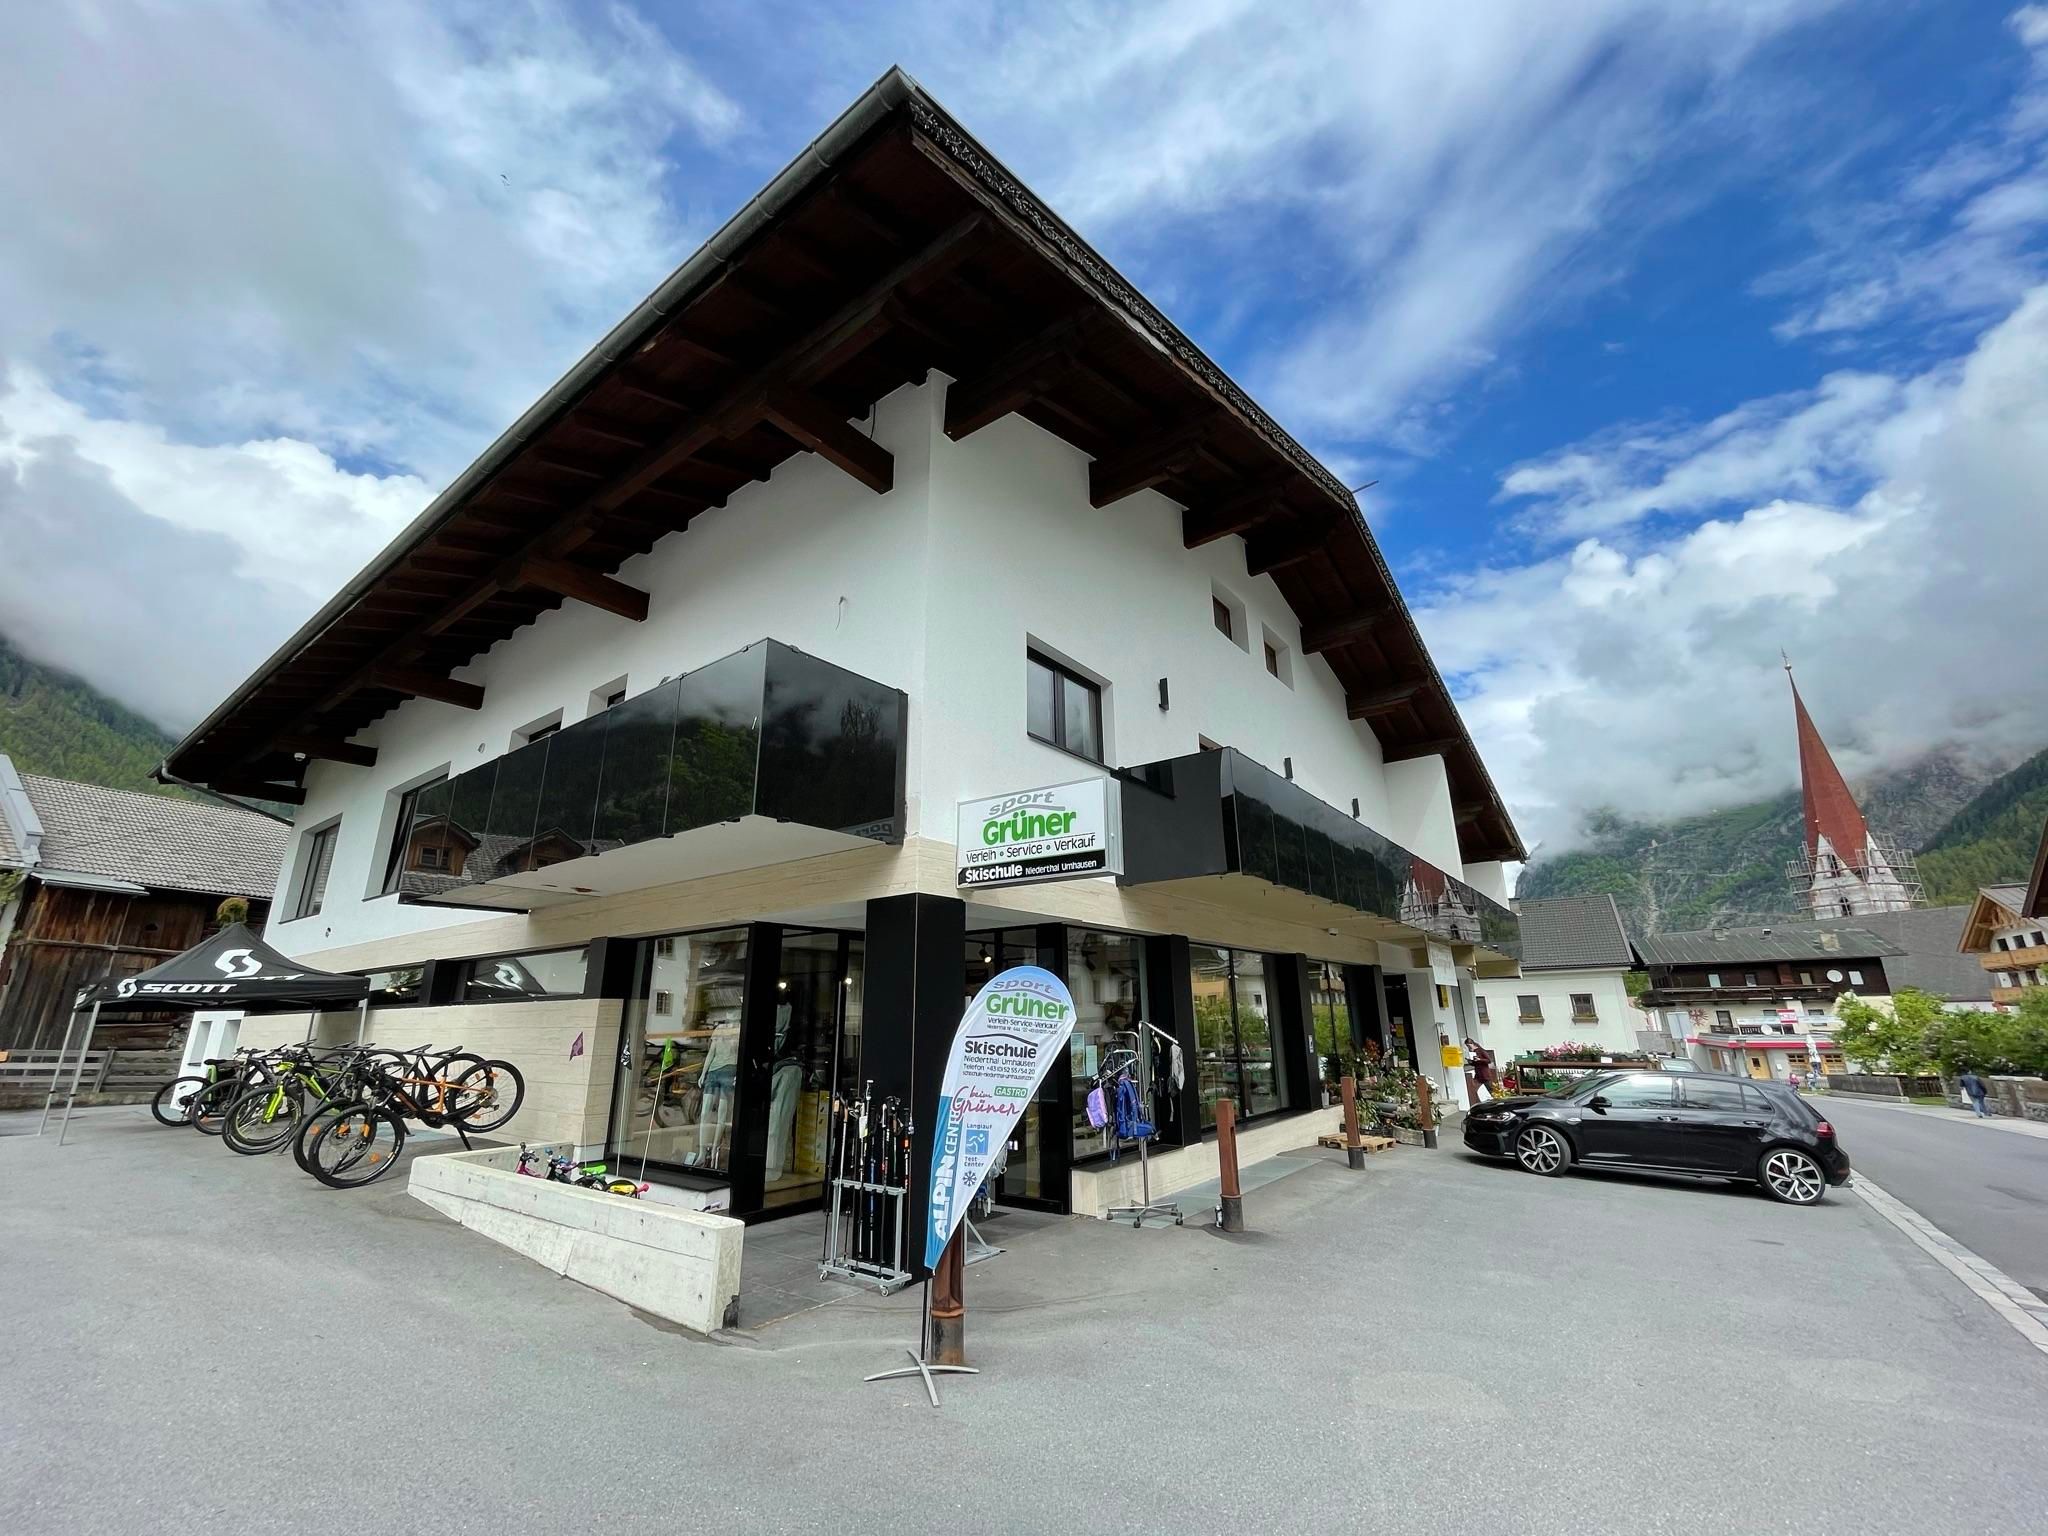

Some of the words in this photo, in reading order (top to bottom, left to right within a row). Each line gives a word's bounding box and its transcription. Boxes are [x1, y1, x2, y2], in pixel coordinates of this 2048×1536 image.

[989, 791, 1055, 815] sport
[983, 810, 1077, 846] Grüner
[966, 850, 997, 864] Verleih
[1006, 844, 1043, 858] Service
[1054, 835, 1095, 852] Verkauf
[965, 864, 1023, 882] Skischule
[1061, 859, 1097, 871] Umhausen
[138, 983, 238, 994] SCOTT
[993, 980, 1054, 994] sport
[986, 992, 1069, 1020] Grüner
[965, 1040, 1037, 1059] Skischule
[963, 1063, 985, 1071] Telefon
[1002, 1059, 1036, 1067] Umhausen
[995, 1087, 1027, 1097] GASTRO
[952, 1086, 1020, 1121] Grüner
